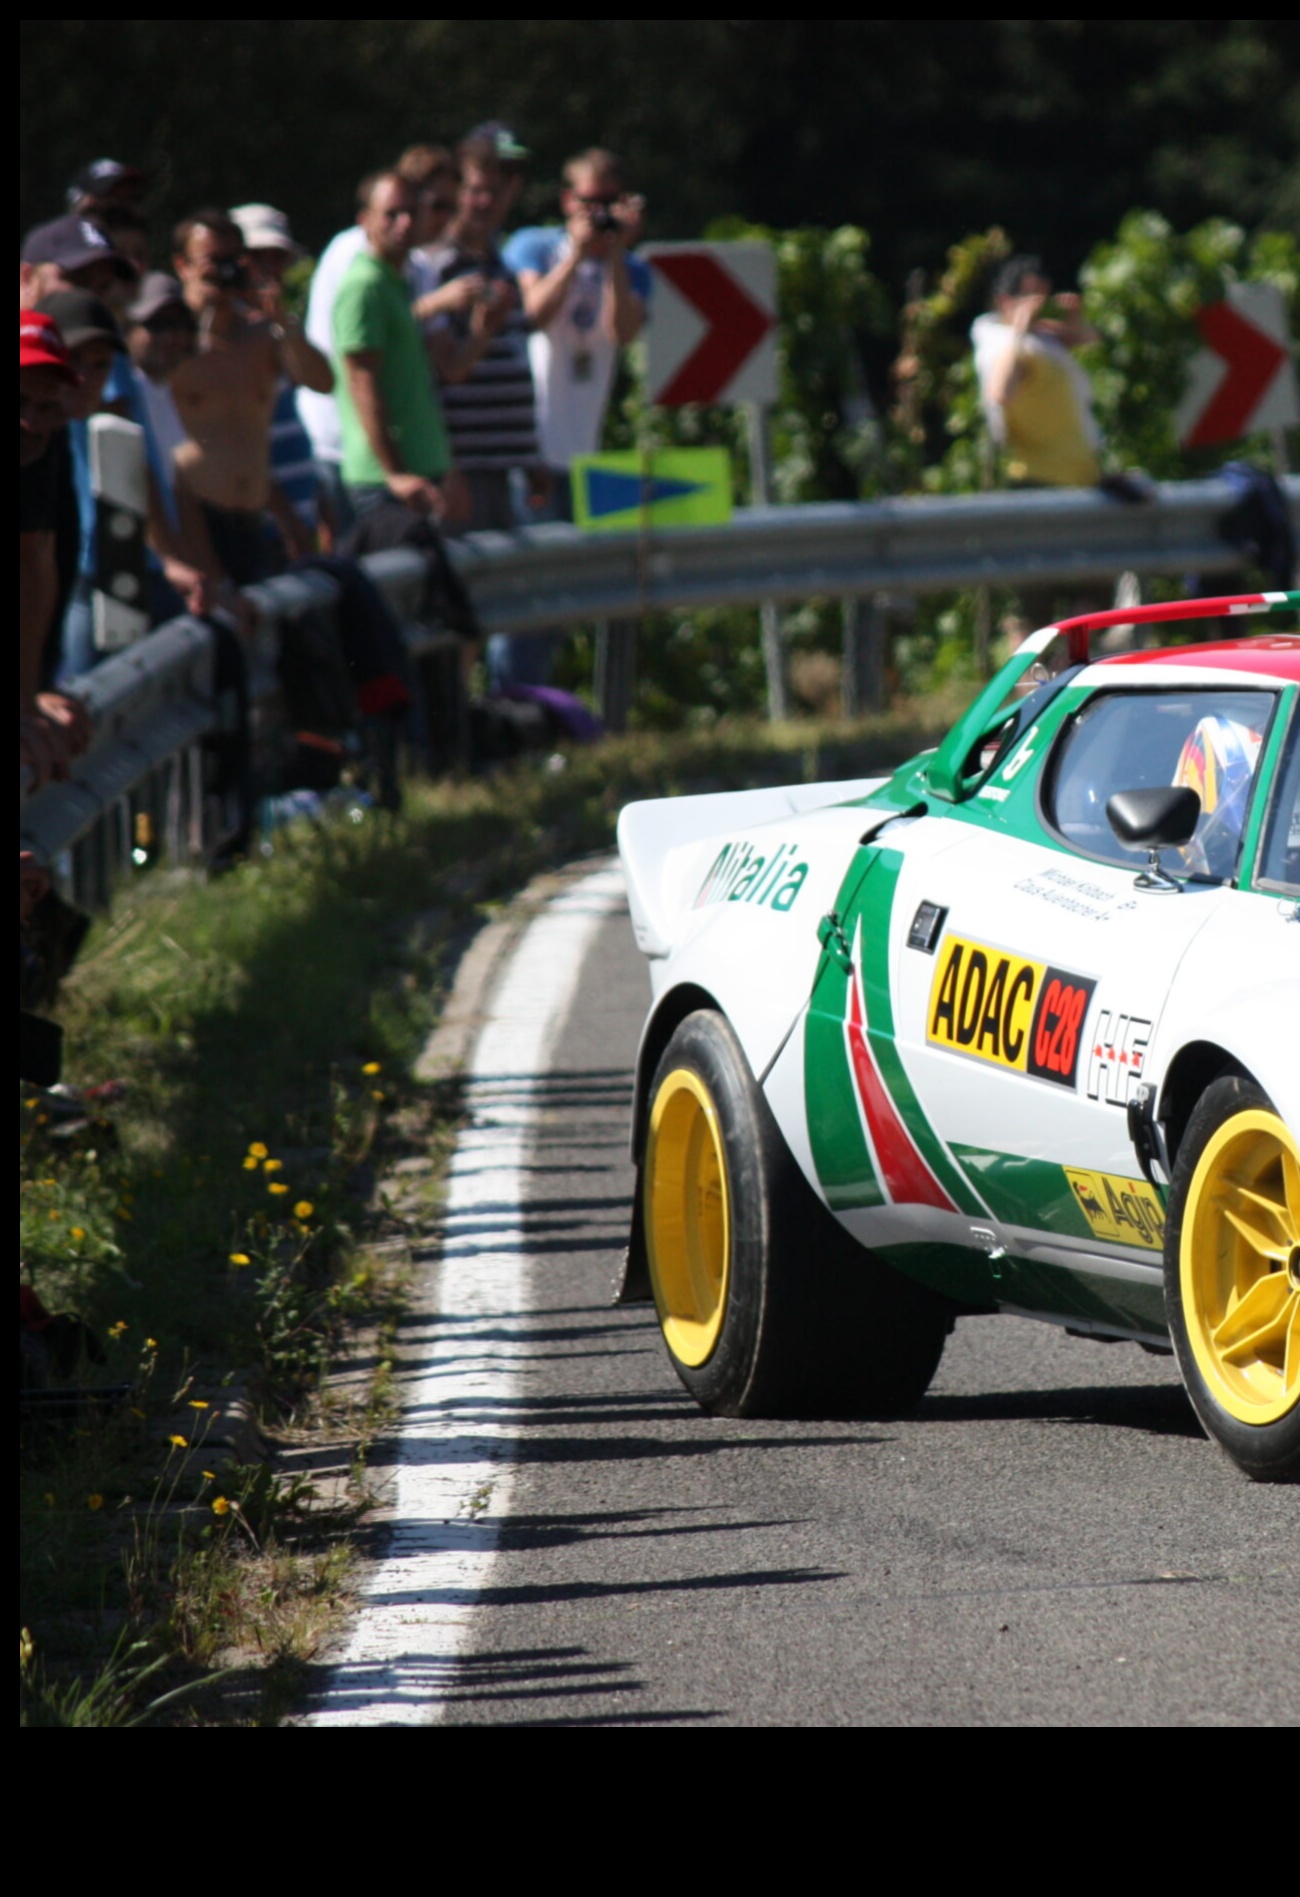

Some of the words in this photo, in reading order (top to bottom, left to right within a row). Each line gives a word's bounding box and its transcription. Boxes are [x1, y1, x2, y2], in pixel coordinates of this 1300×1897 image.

[691, 841, 809, 912] Alitalia
[931, 943, 1035, 1064] ADAC
[1034, 978, 1088, 1076] C28
